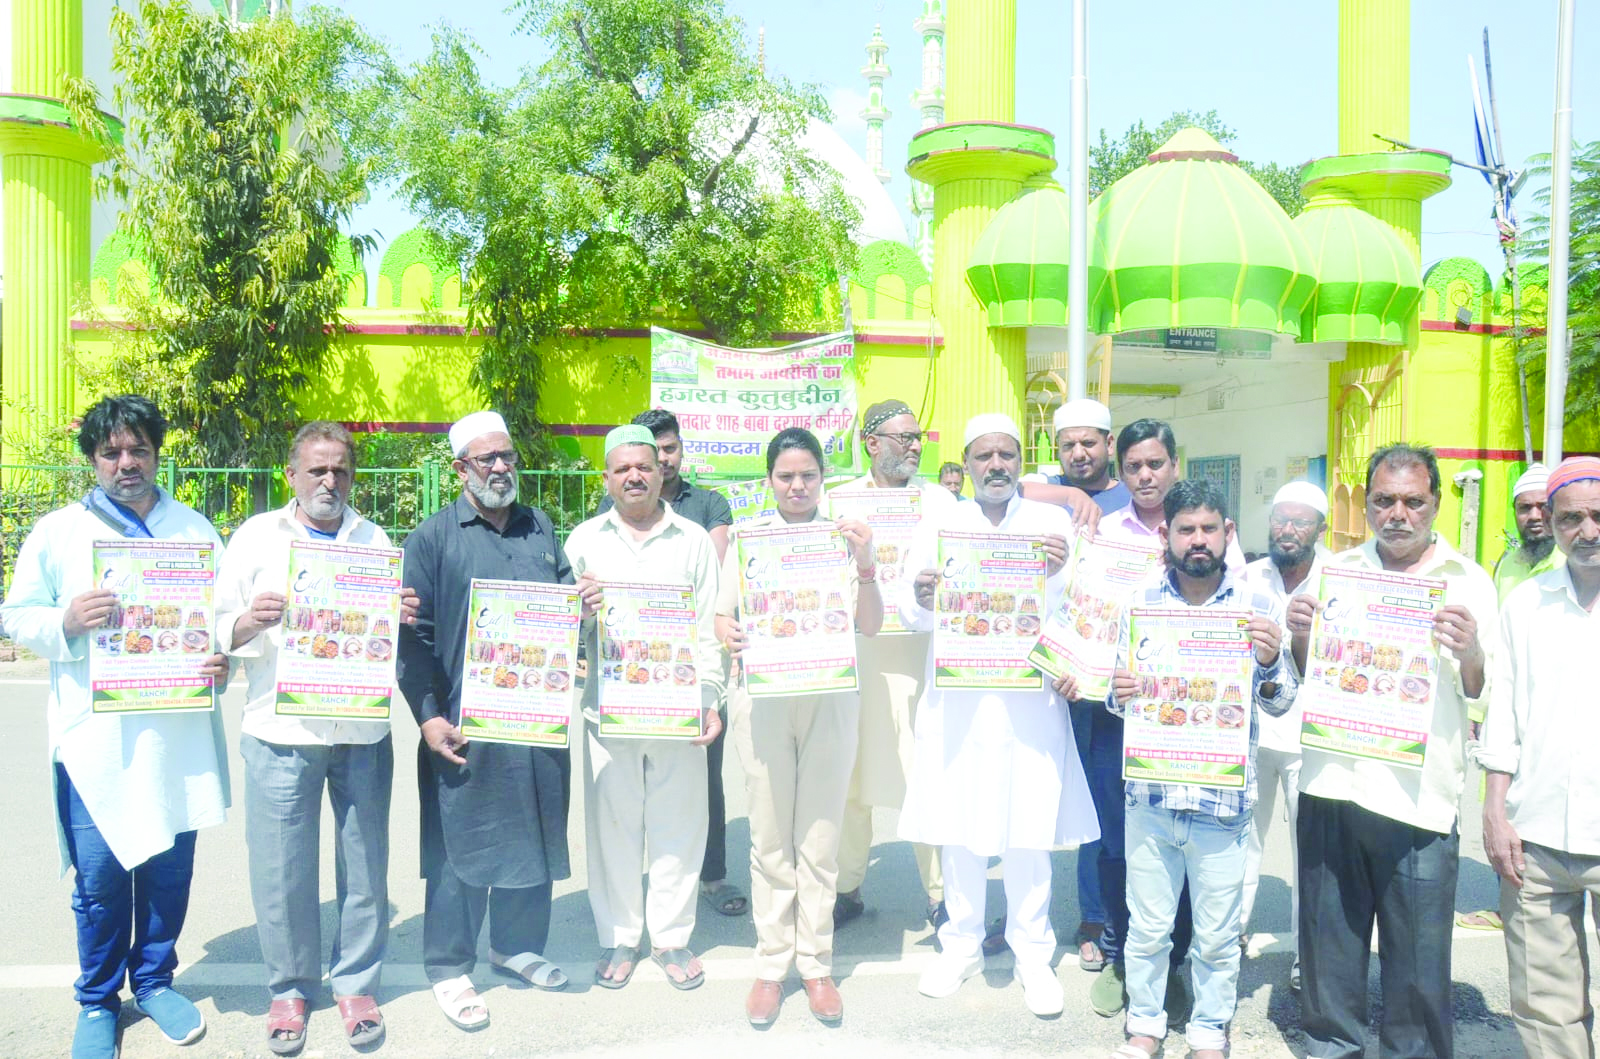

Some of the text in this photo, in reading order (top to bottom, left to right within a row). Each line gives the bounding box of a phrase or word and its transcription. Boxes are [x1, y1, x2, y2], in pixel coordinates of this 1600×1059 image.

[1170, 328, 1216, 338] ENTRANCE
[824, 343, 853, 357] आप
[715, 366, 755, 379] तमाम
[821, 366, 842, 379] का
[659, 387, 728, 403] हजरत
[716, 414, 740, 433] शाह
[744, 414, 769, 432] बाबा
[745, 556, 770, 579] Eid
[942, 556, 968, 578] Eid
[100, 567, 130, 590] Eid
[293, 569, 322, 593] Eid
[748, 579, 779, 589] EXPO
[945, 580, 975, 588] EXPO
[294, 595, 328, 605] EXPO
[1322, 597, 1351, 621] Eid
[476, 607, 502, 628] Eid
[604, 606, 628, 627] Eid
[477, 630, 508, 640] EXPO
[607, 629, 635, 637] EXPO
[1323, 623, 1359, 637] EXPO
[1136, 636, 1164, 661] Eid
[1138, 663, 1172, 672] EXPO
[1347, 732, 1377, 744] RANCHI
[1170, 762, 1198, 770] RANCHI
